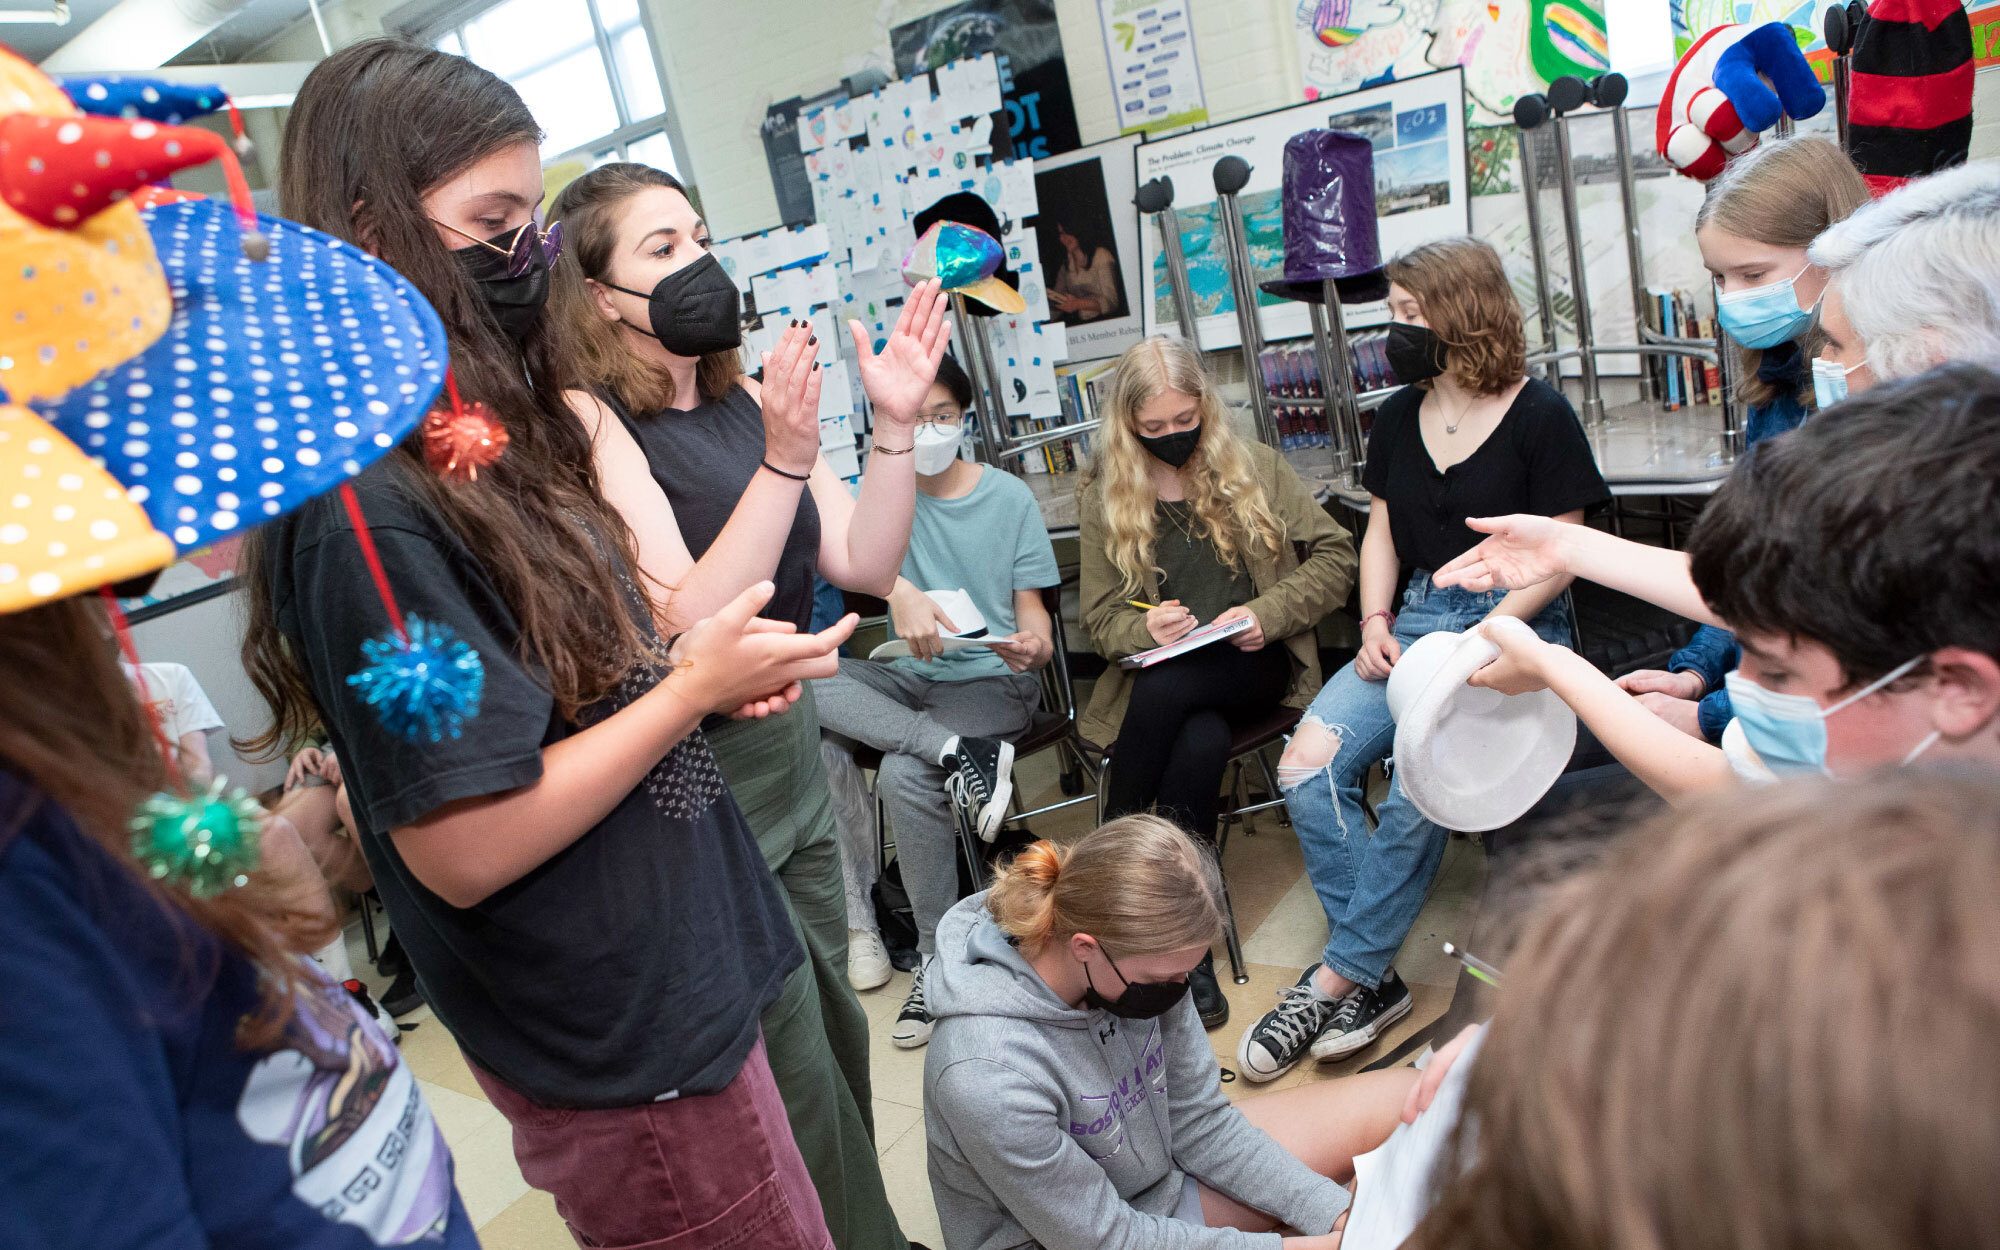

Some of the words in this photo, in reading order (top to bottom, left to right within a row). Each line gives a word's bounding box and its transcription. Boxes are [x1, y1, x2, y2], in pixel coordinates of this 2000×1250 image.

[1148, 157, 1160, 166] The
[1162, 149, 1193, 163] Problem:
[1196, 142, 1224, 155] Climate
[1226, 135, 1256, 149] Change
[1069, 335, 1087, 345] BLS
[1088, 331, 1117, 342] Member
[1118, 326, 1143, 337] Rebec
